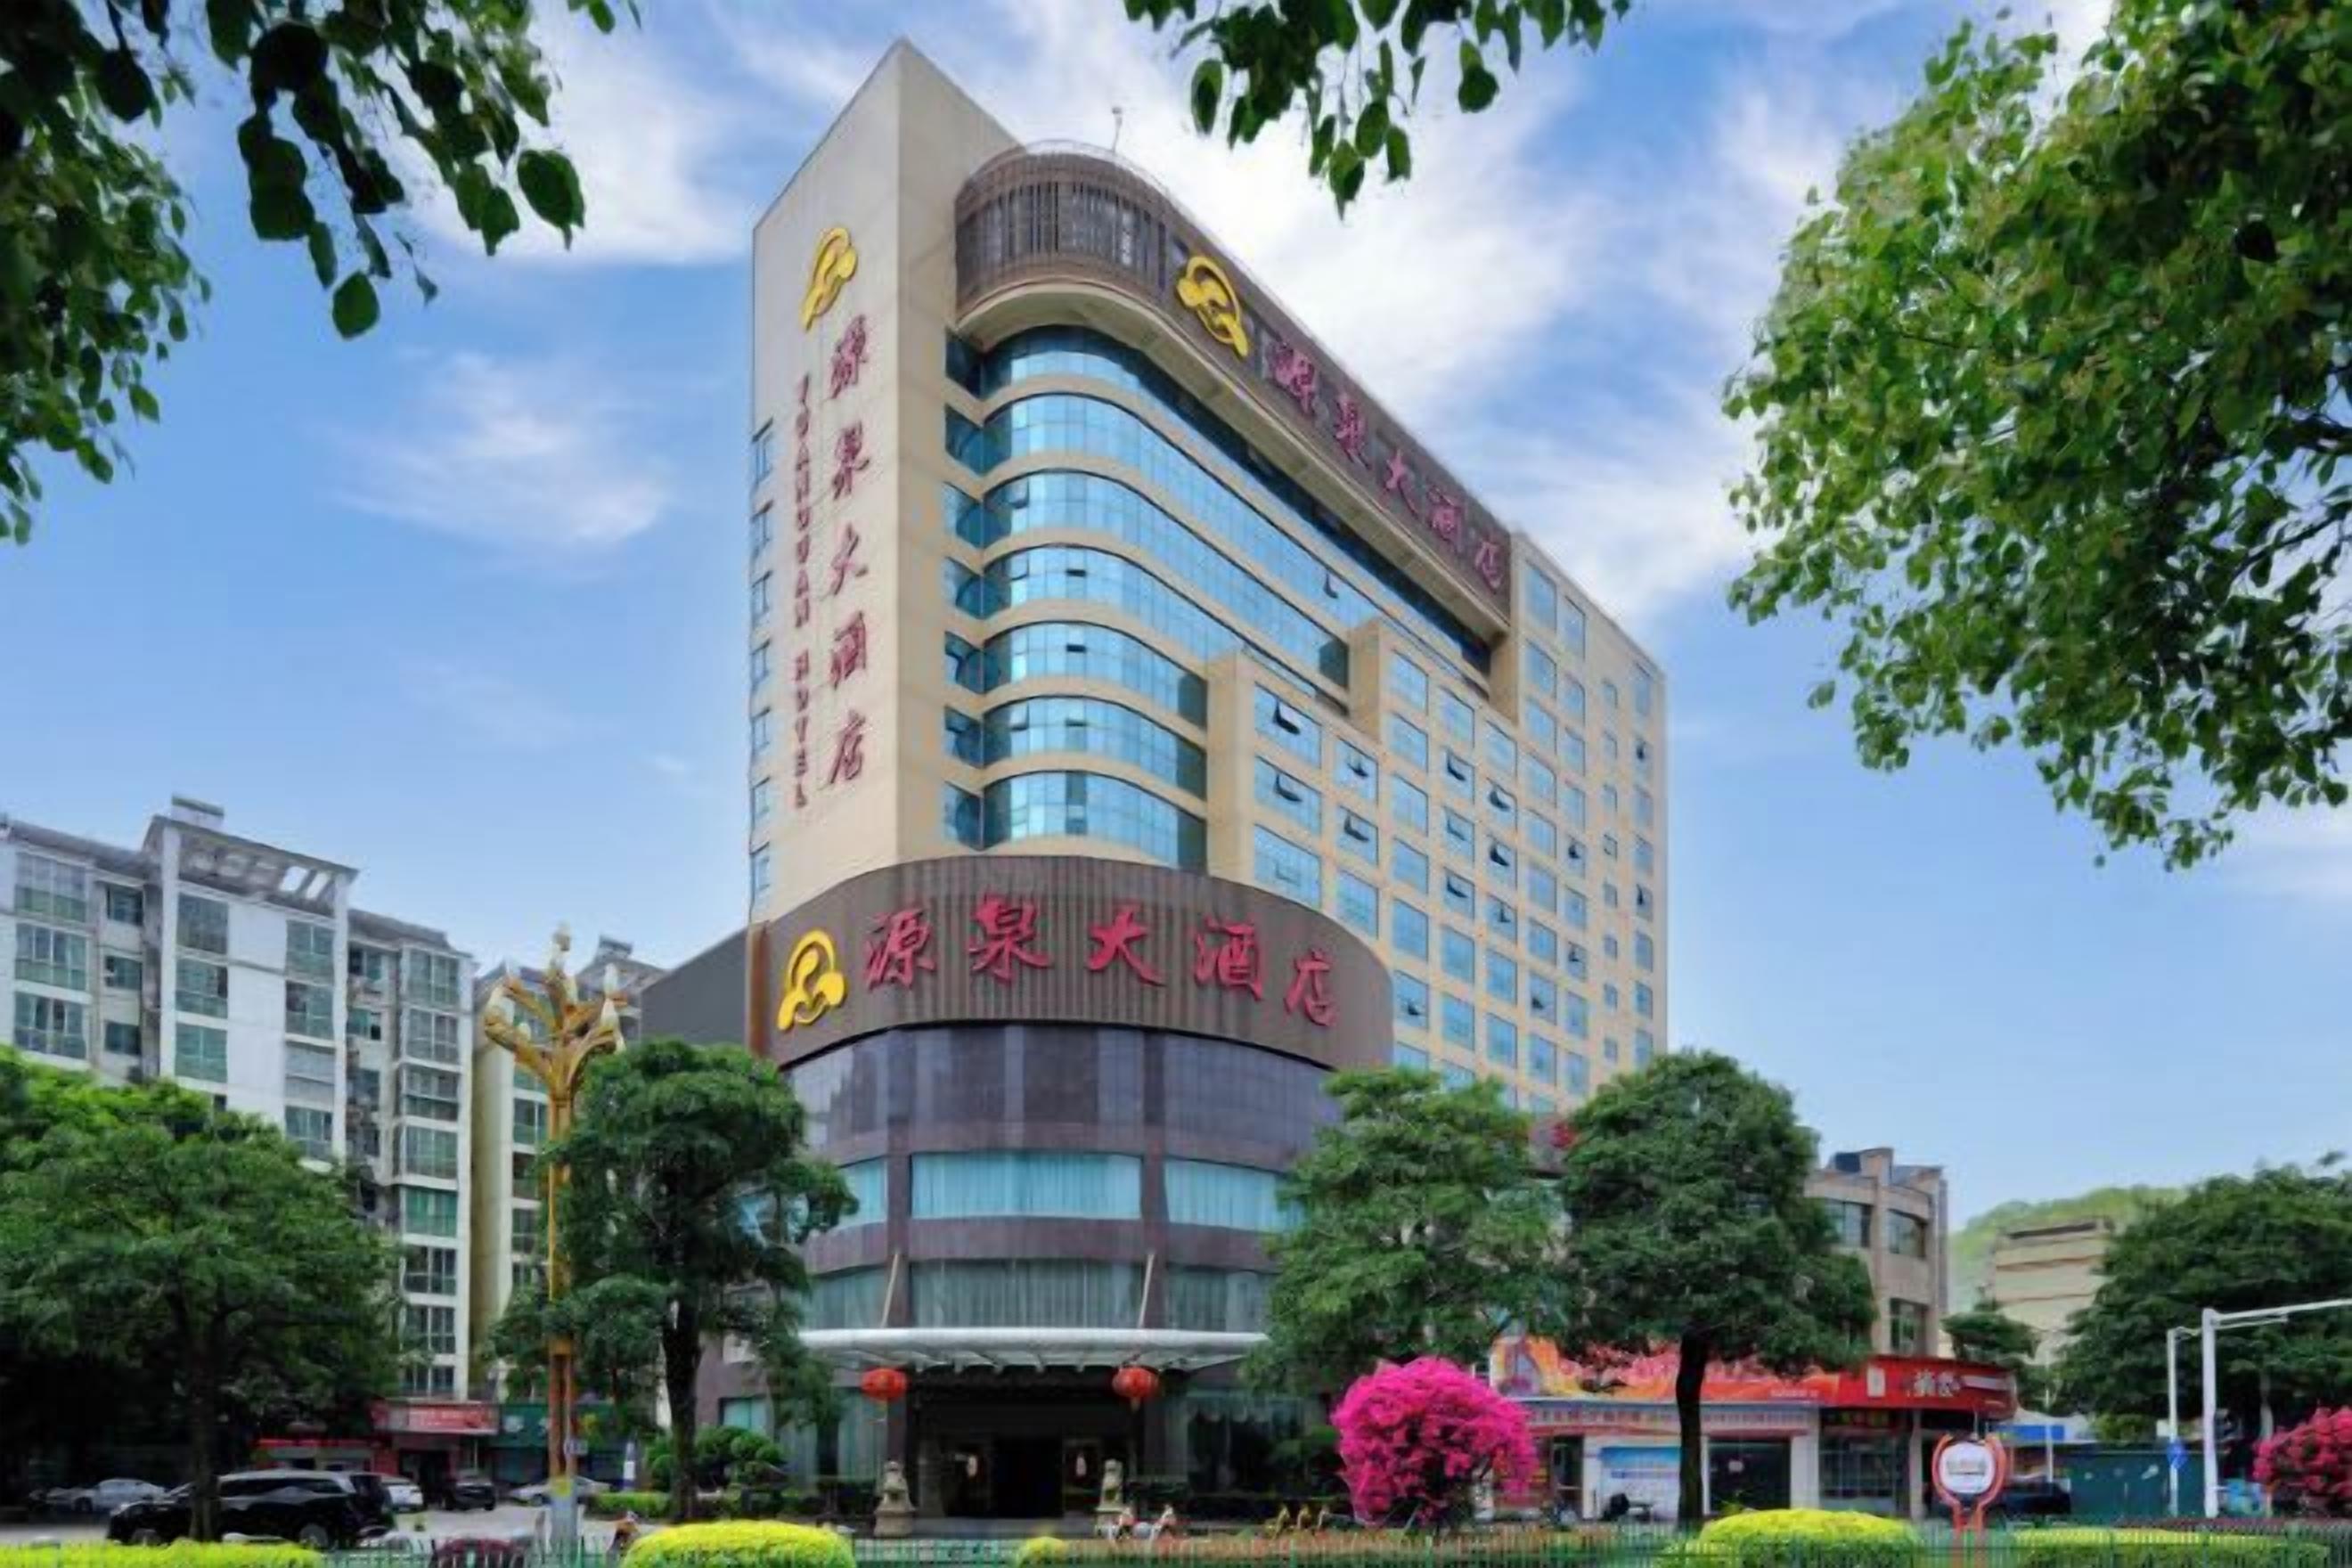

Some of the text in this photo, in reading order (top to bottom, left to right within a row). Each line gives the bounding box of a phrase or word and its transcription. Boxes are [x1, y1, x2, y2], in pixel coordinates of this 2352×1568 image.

[1269, 339, 1504, 594] 源泉大酒店
[862, 893, 1335, 1027] 源泉大酒店
